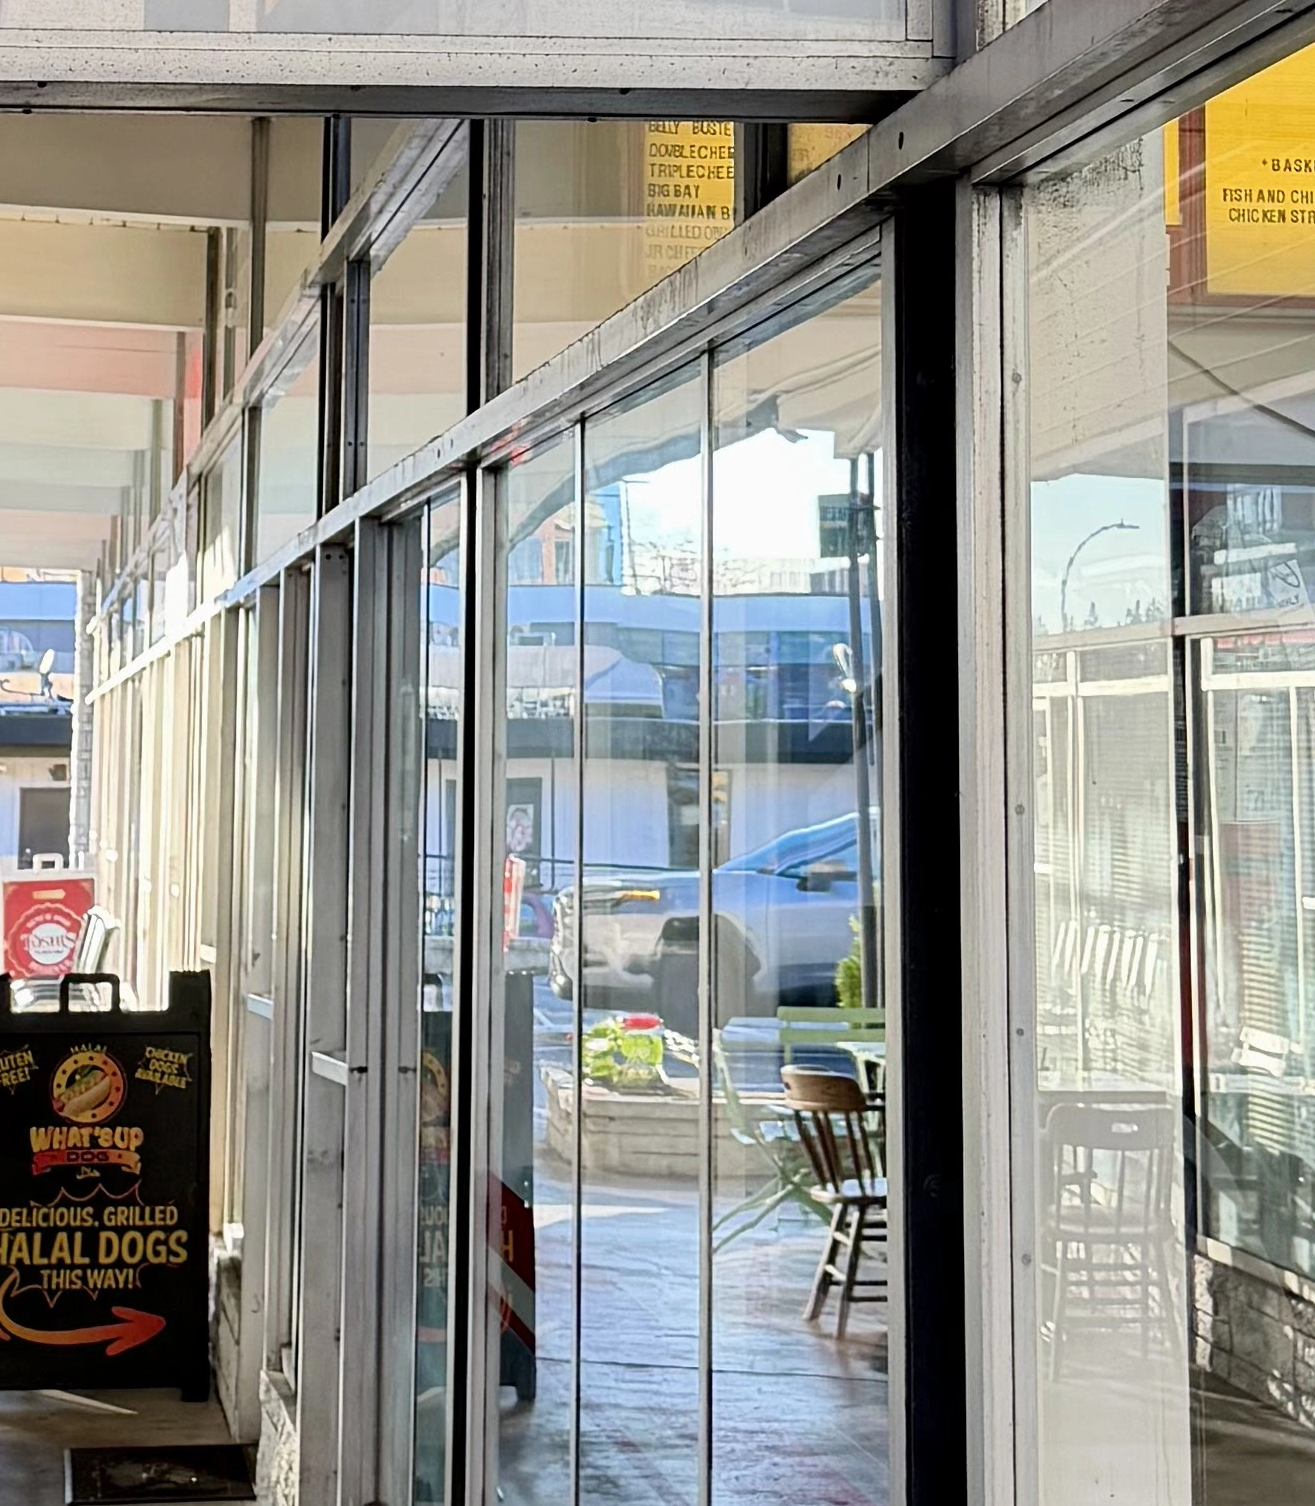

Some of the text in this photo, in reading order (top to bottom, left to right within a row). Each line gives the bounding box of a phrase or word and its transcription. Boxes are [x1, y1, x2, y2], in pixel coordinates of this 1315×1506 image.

[648, 183, 701, 199] BIG BAY
[1222, 188, 1253, 203] FISH
[1256, 189, 1285, 204] AND
[646, 203, 717, 220] HAWAIIAN
[1228, 208, 1286, 224] CHICKEN
[66, 1150, 110, 1162] DOG
[103, 1205, 179, 1226] GRILLED
[98, 1229, 189, 1265] DOGS
[40, 1268, 134, 1290] THIS WAY!
